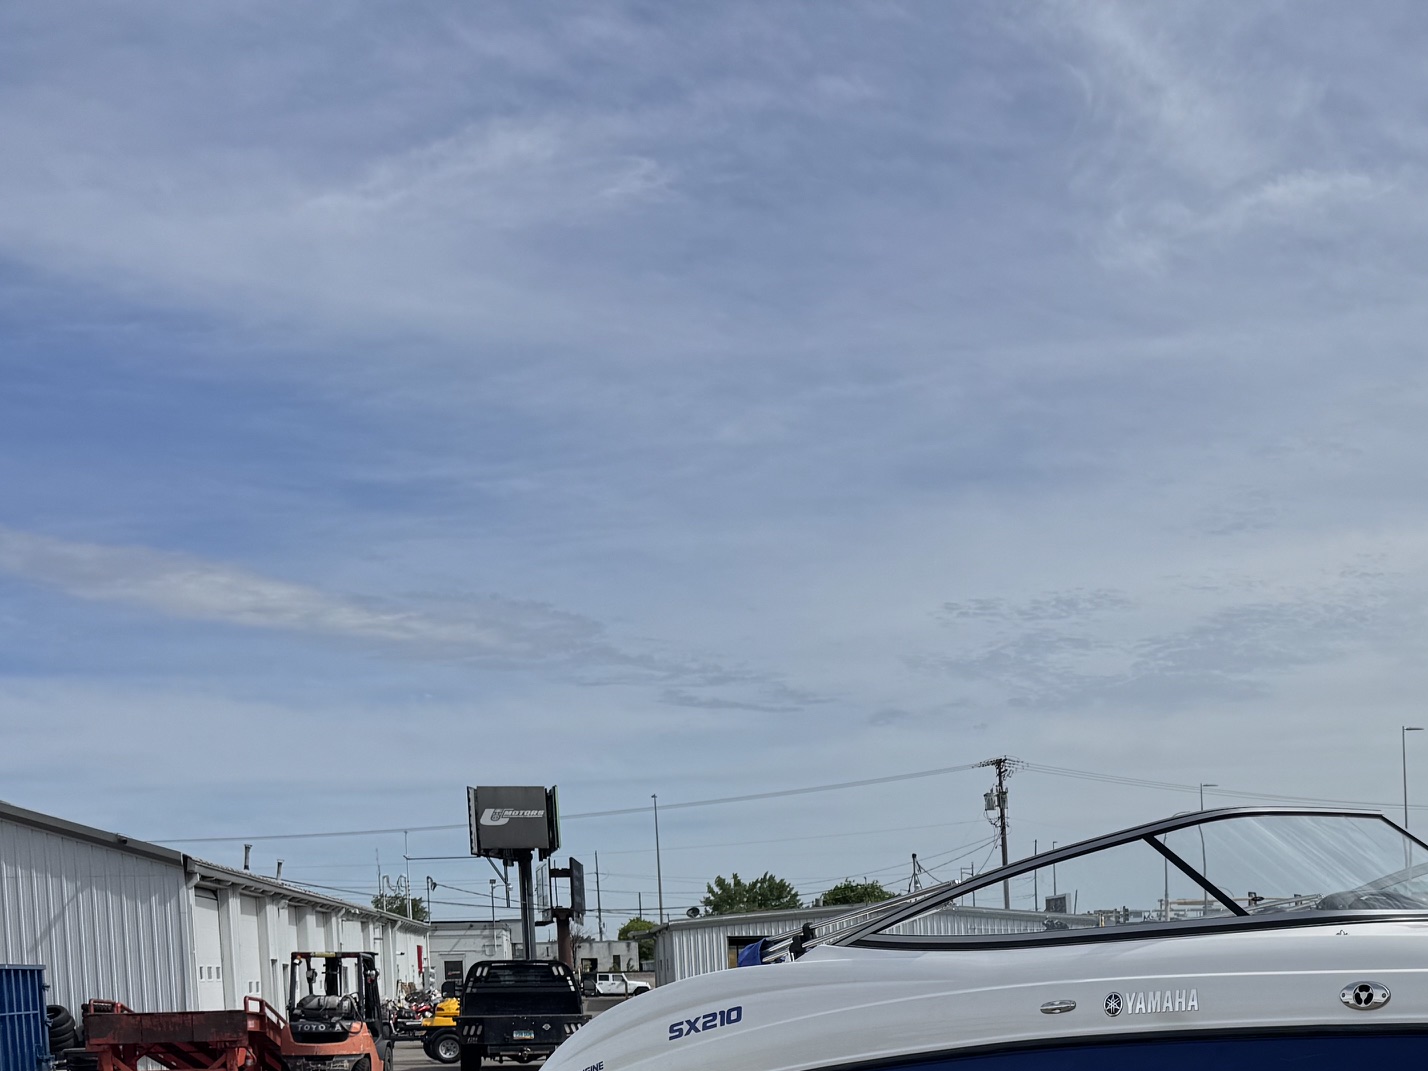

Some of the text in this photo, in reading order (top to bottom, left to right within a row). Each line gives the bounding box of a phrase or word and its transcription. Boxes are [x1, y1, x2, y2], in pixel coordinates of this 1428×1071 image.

[504, 809, 545, 817] MOTORS
[1125, 988, 1199, 1015] YAMAHA
[297, 1023, 342, 1032] TOYOA
[668, 1005, 743, 1041] SX210
